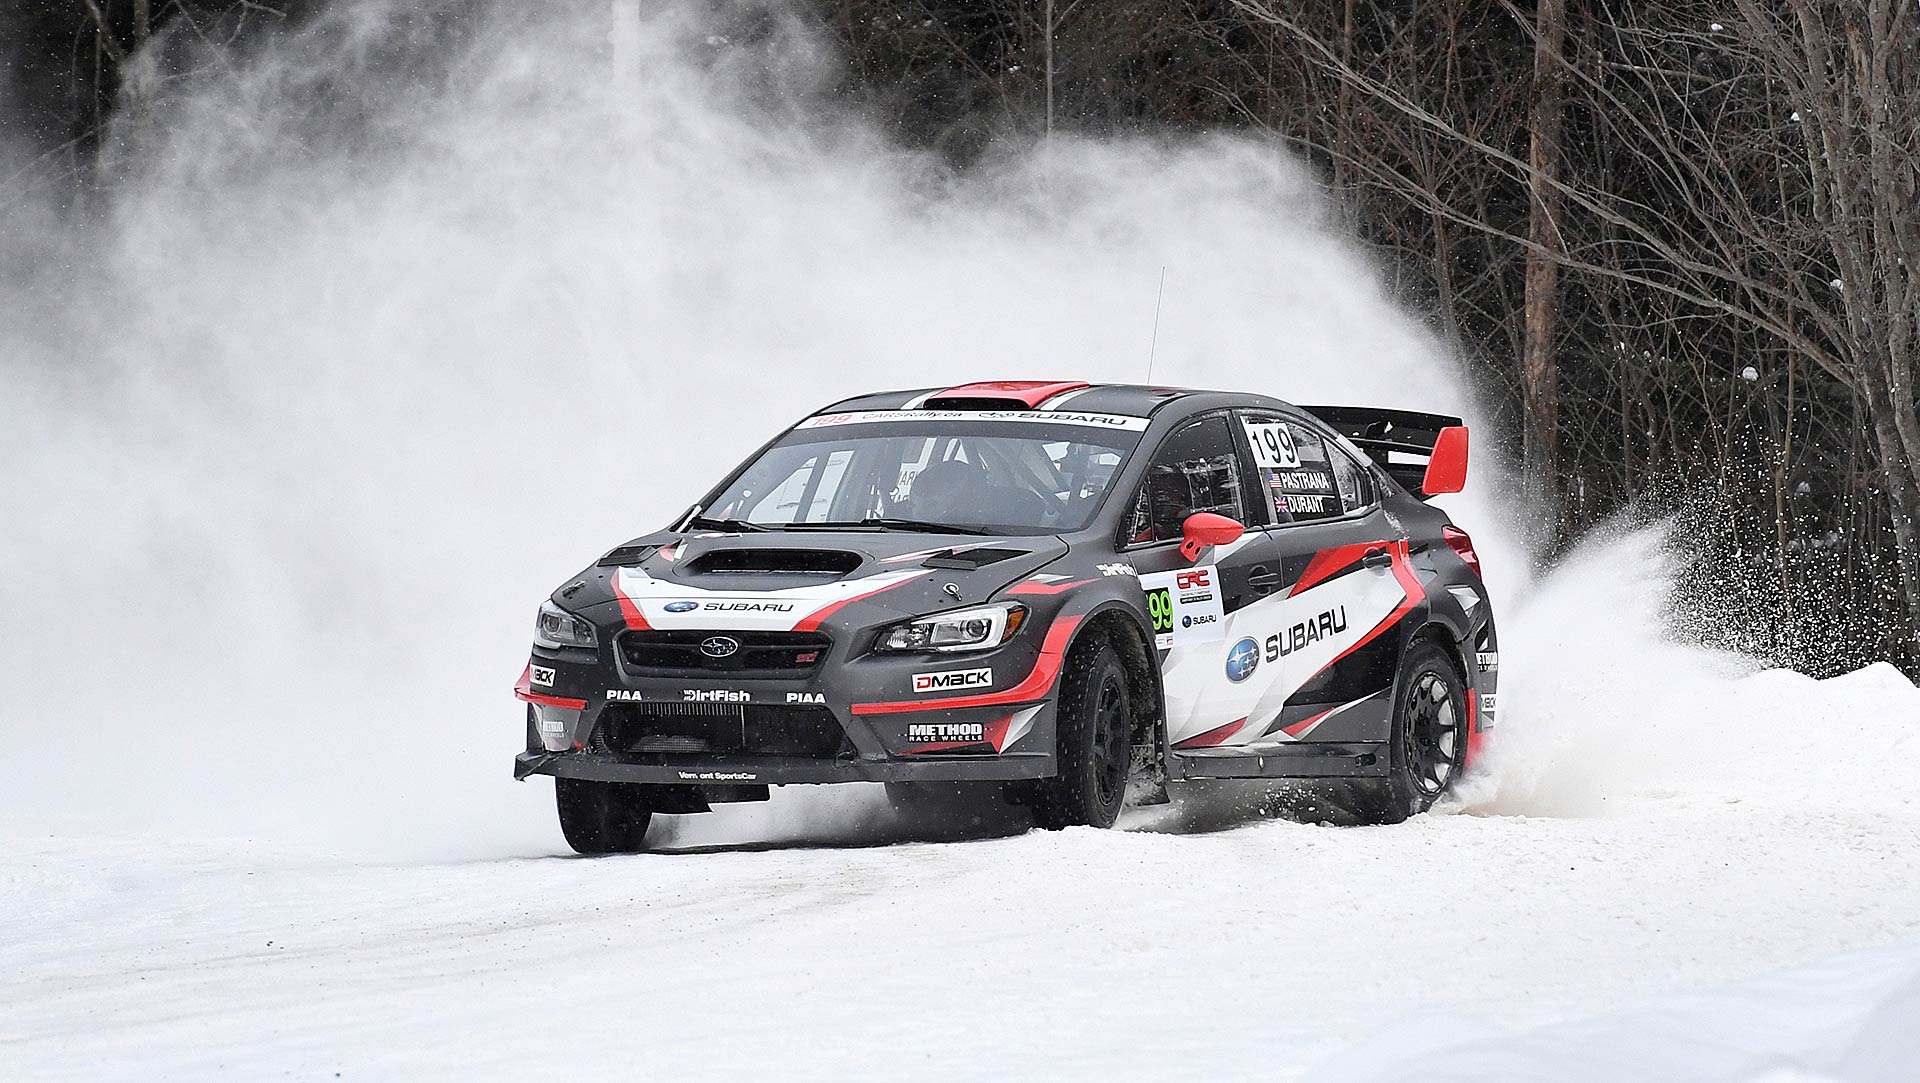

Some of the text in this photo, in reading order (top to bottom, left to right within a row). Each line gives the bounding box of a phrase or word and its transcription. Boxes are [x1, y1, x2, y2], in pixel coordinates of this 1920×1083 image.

[811, 414, 853, 426] 199
[1018, 412, 1127, 426] SUBARU
[1252, 427, 1296, 464] 199
[1280, 472, 1330, 489] PASTRANA
[1287, 496, 1325, 513] DURANT
[703, 602, 794, 613] SUBARU
[1193, 614, 1217, 625] SUBARU
[1265, 605, 1347, 663] SUBARU
[606, 690, 642, 700] PIAA
[683, 690, 751, 702] DirtFish
[786, 692, 826, 704] PIAA
[909, 723, 983, 736] METHOD
[715, 772, 757, 780] SportsCar
